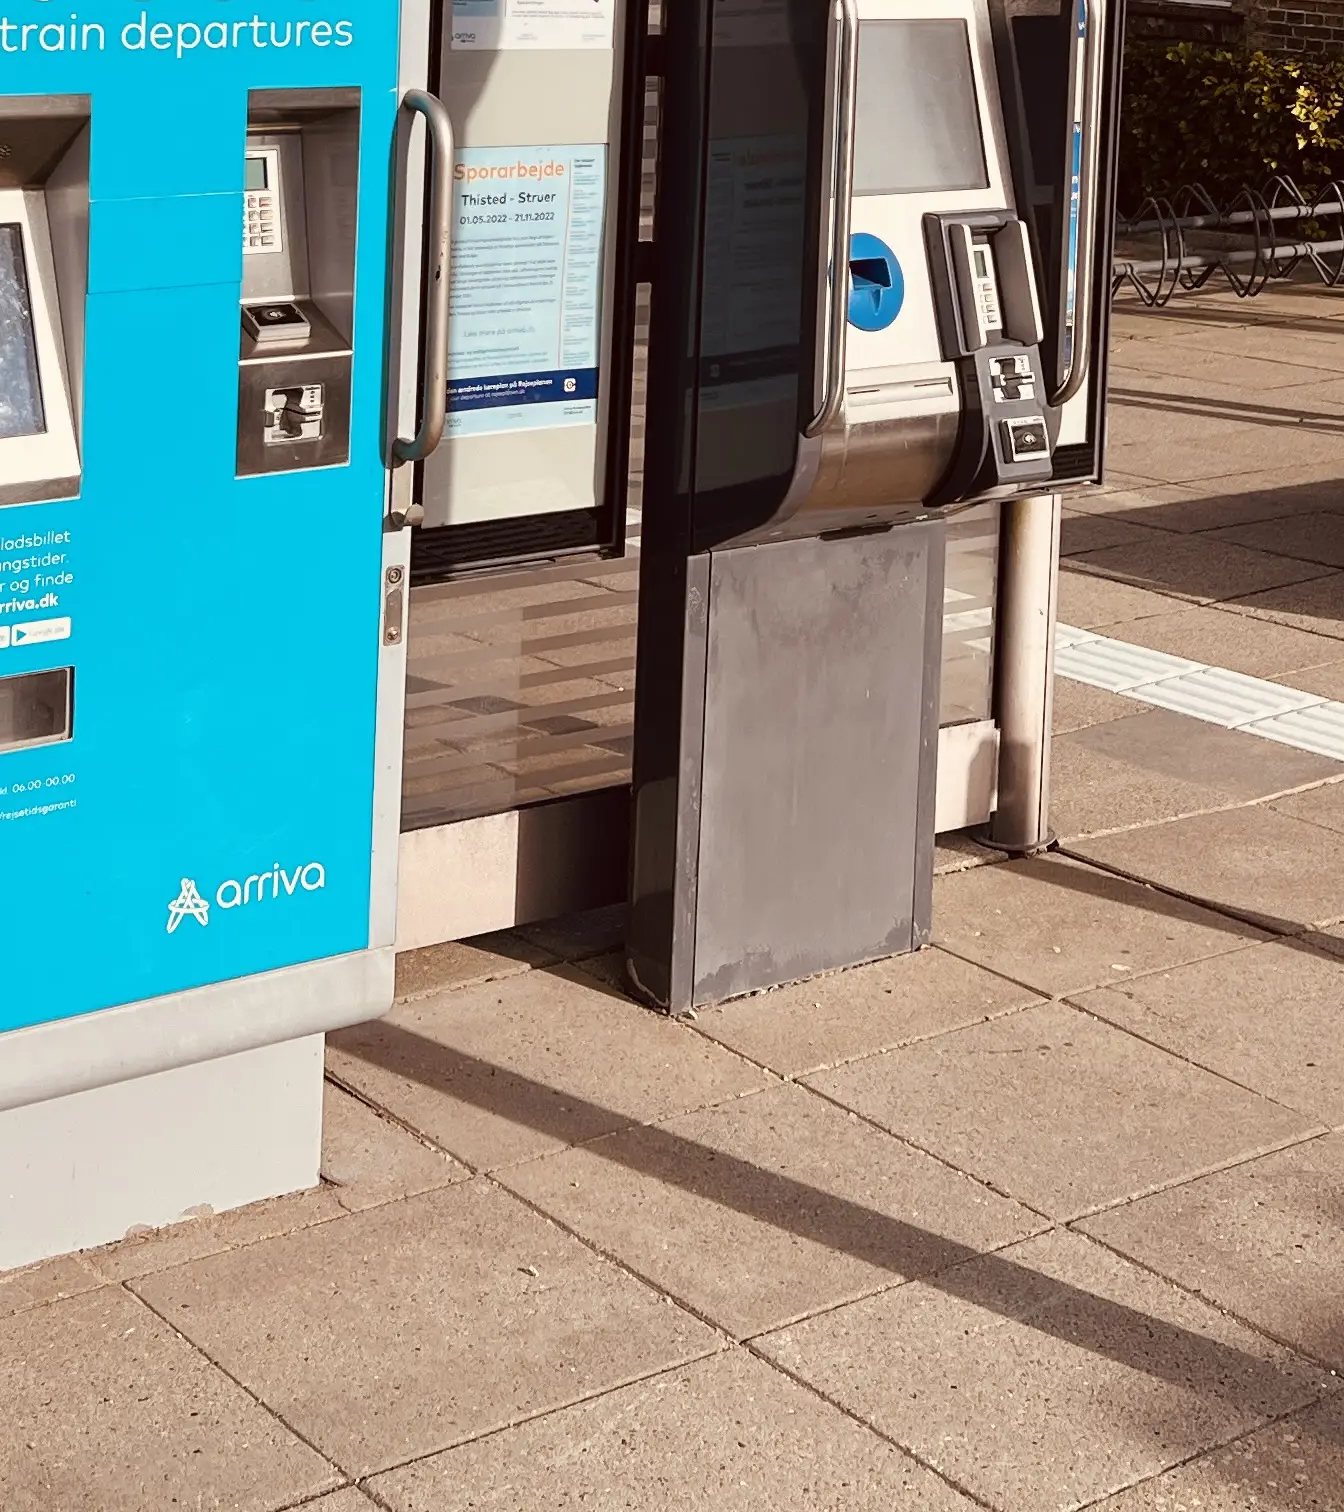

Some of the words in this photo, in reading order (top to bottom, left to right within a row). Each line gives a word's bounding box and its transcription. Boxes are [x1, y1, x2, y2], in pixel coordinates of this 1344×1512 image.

[121, 10, 353, 58] departures
[454, 160, 565, 183] Sporarbejde
[461, 192, 507, 206] Thisted
[518, 191, 556, 204] Struer
[460, 214, 507, 225] 01.05.2022
[9, 578, 30, 594] og
[34, 570, 74, 588] finde
[215, 861, 326, 909] arriva
